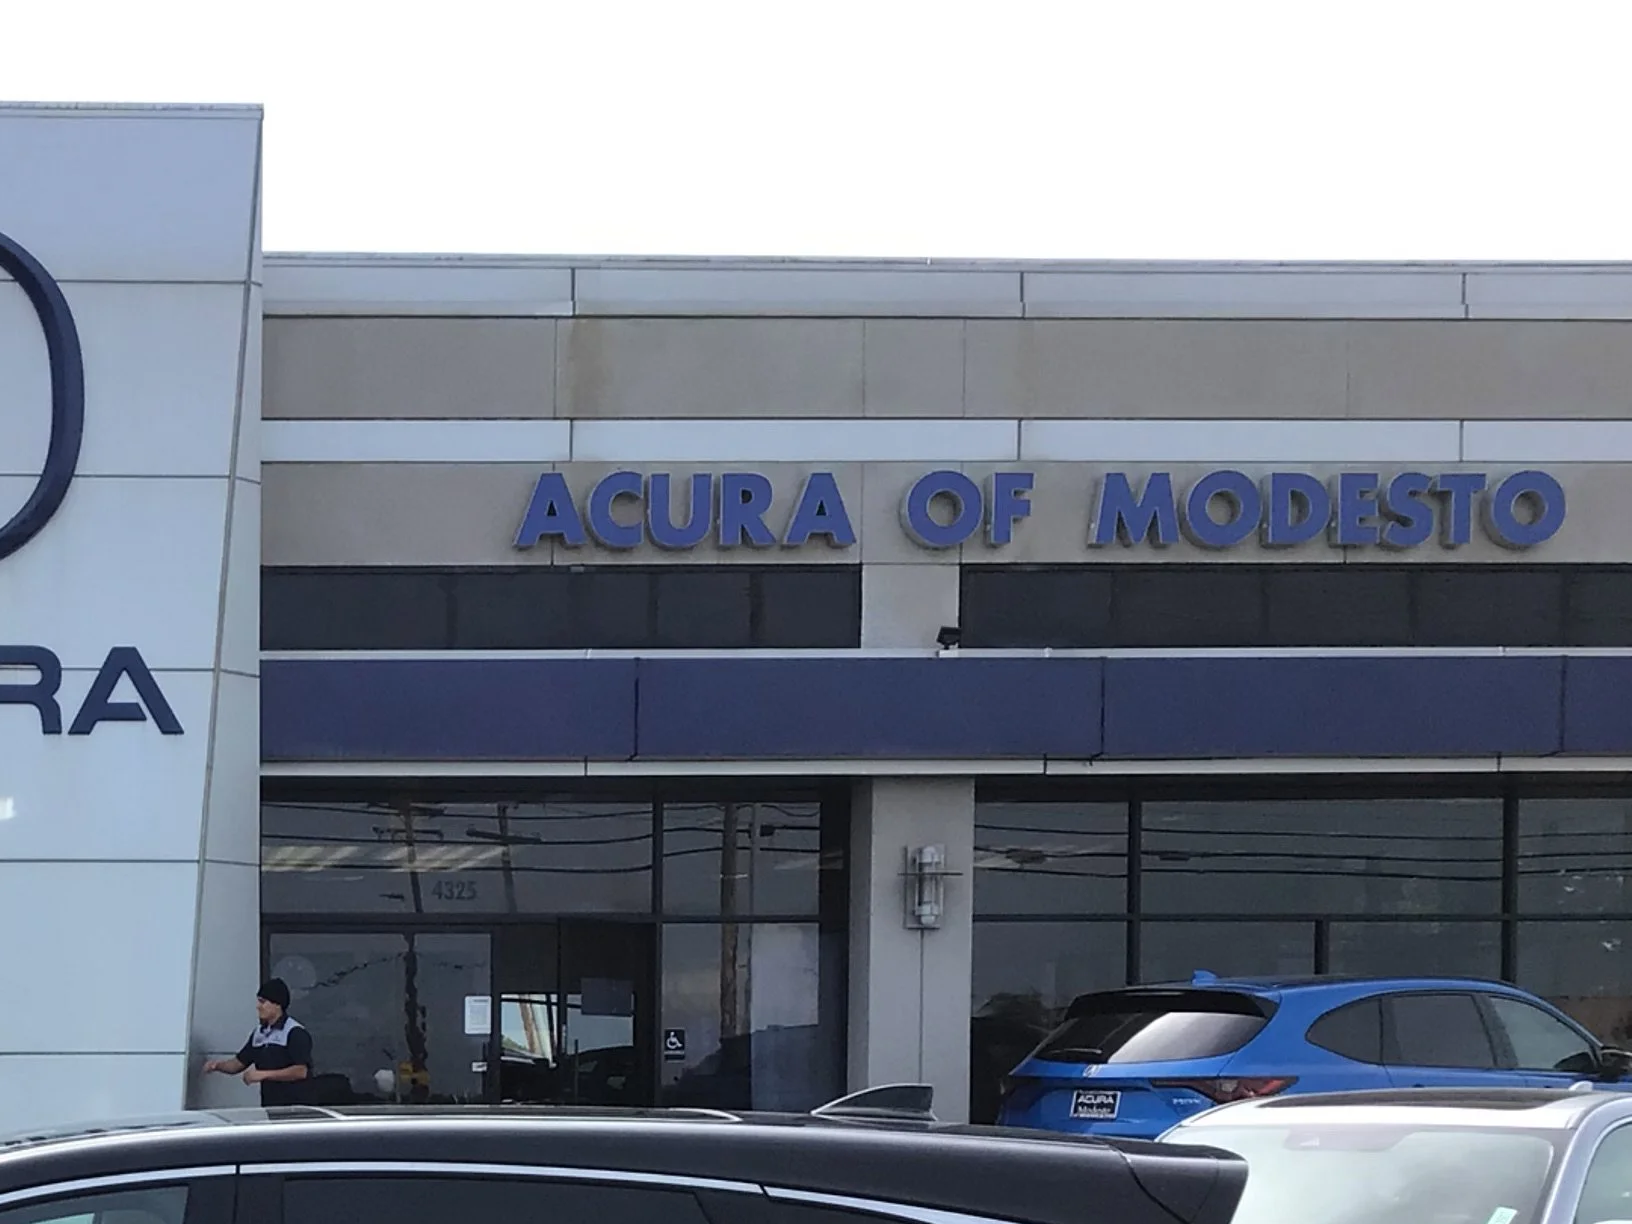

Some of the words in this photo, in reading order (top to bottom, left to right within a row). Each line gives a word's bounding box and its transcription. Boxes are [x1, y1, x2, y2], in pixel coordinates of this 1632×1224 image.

[512, 470, 858, 550] ACURA
[902, 470, 1035, 549] OF
[1089, 469, 1567, 549] MODESTO
[431, 880, 478, 900] 4325
[1077, 1094, 1114, 1104] ACURA
